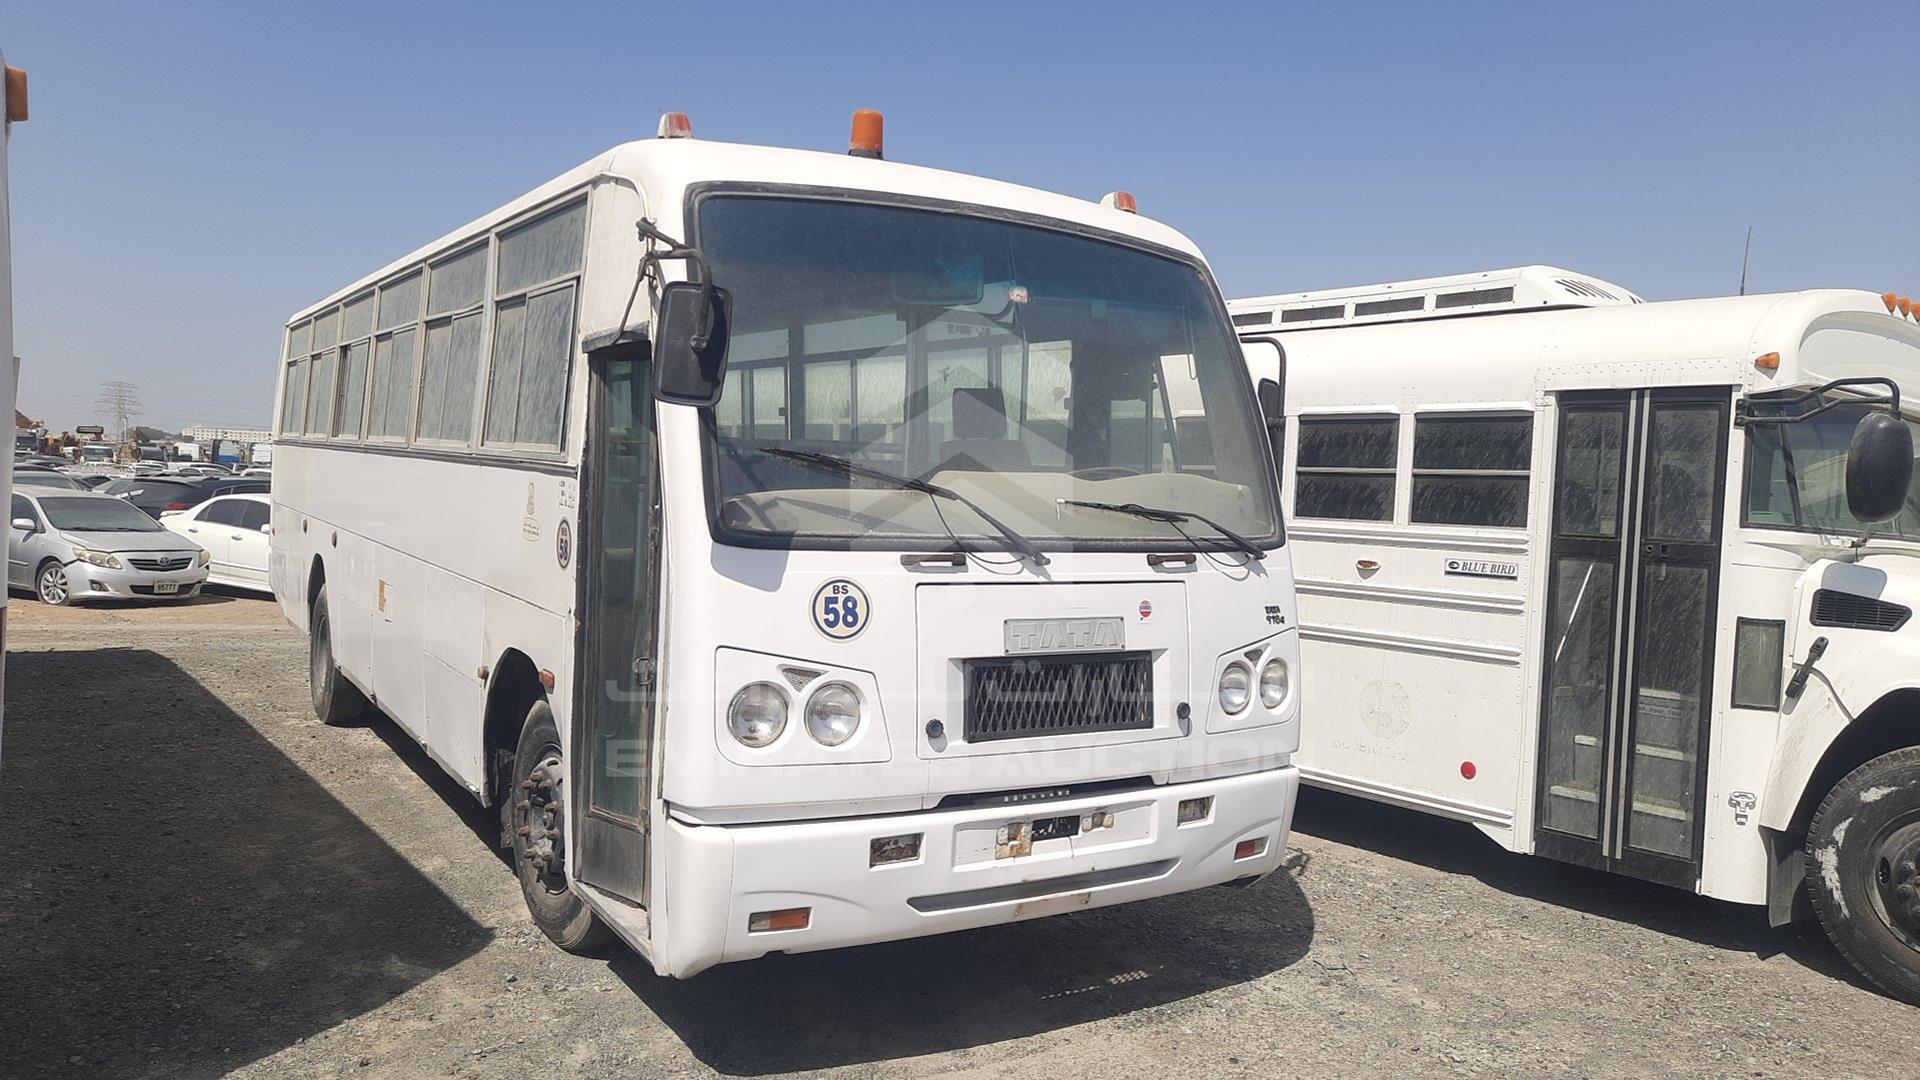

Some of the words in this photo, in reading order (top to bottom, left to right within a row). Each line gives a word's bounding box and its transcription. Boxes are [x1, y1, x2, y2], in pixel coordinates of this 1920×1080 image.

[559, 538, 568, 561] 58
[1461, 561, 1489, 573] BLUE
[1489, 563, 1516, 575] BIRD
[832, 584, 849, 595] BS
[823, 595, 859, 629] 58
[1011, 621, 1119, 650] TATA
